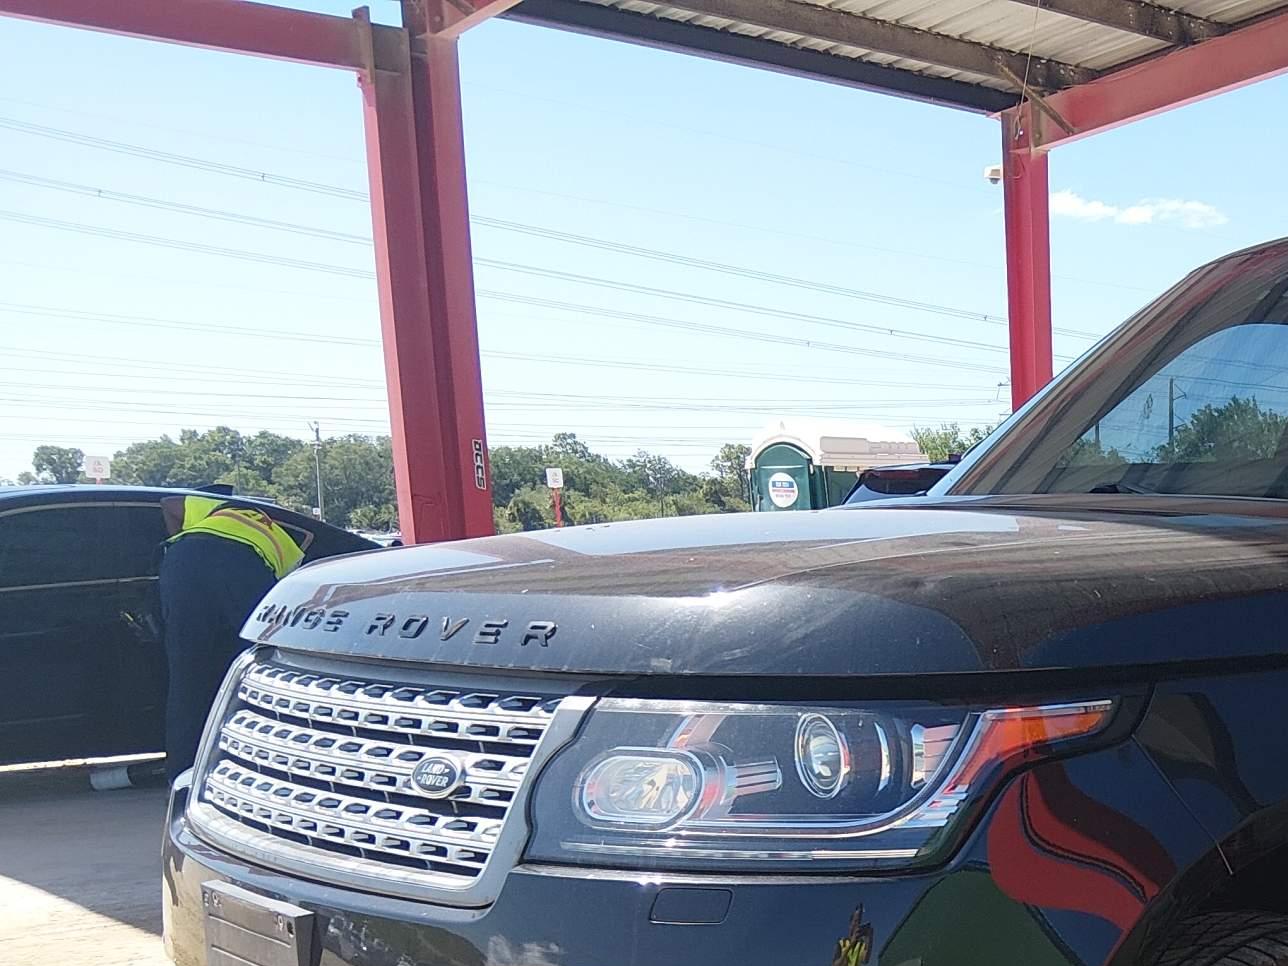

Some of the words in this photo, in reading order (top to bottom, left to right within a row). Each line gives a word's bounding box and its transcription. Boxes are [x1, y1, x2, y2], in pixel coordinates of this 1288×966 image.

[256, 603, 349, 633] RANGE
[364, 613, 558, 648] ROVER
[420, 773, 449, 787] ROVER
